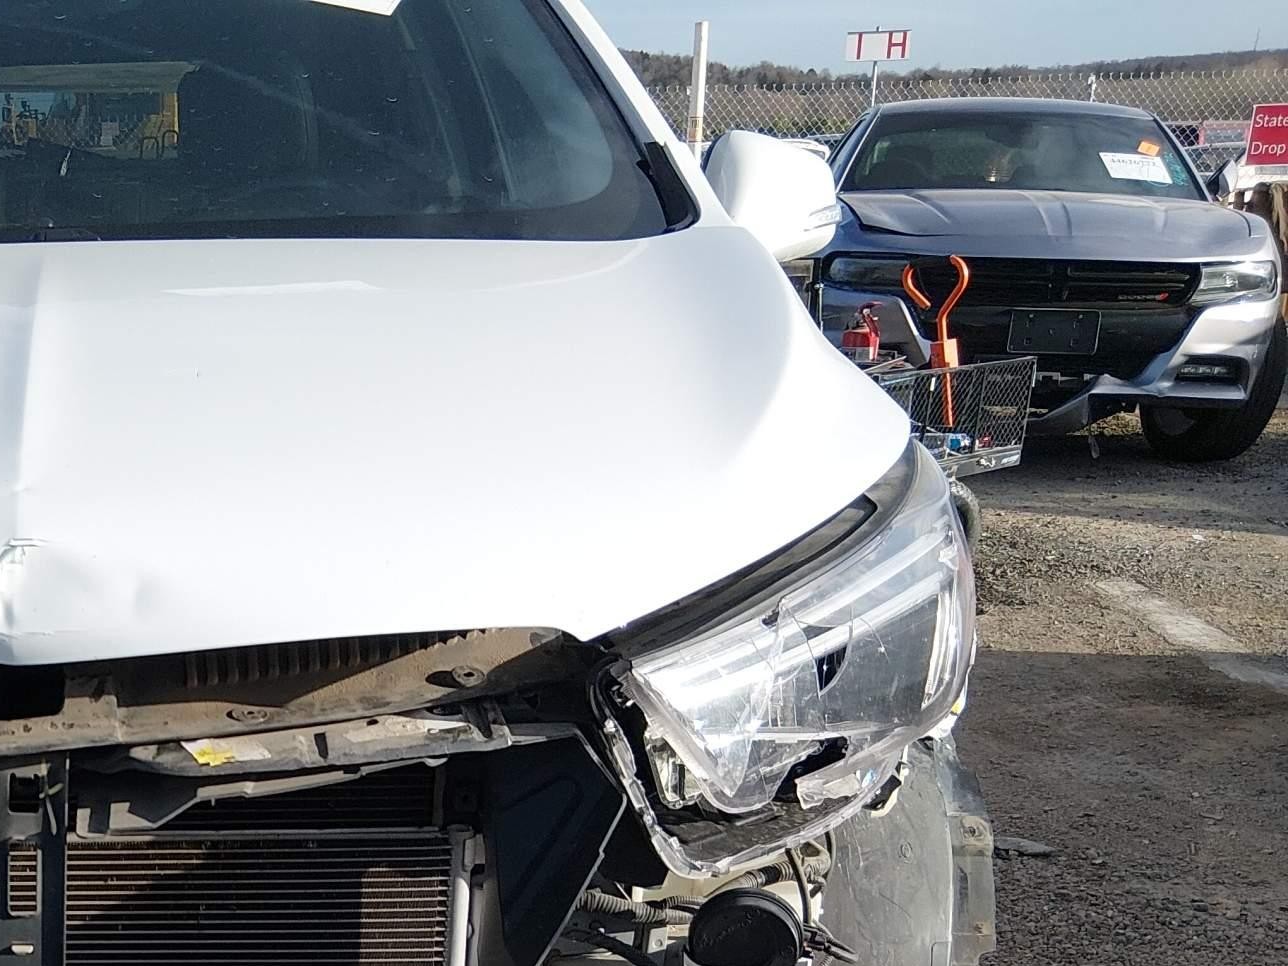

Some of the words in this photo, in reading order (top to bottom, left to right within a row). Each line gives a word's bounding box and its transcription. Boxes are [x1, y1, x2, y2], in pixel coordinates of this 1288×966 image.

[886, 31, 908, 59] H
[1255, 113, 1288, 128] State
[1250, 141, 1286, 157] Drop
